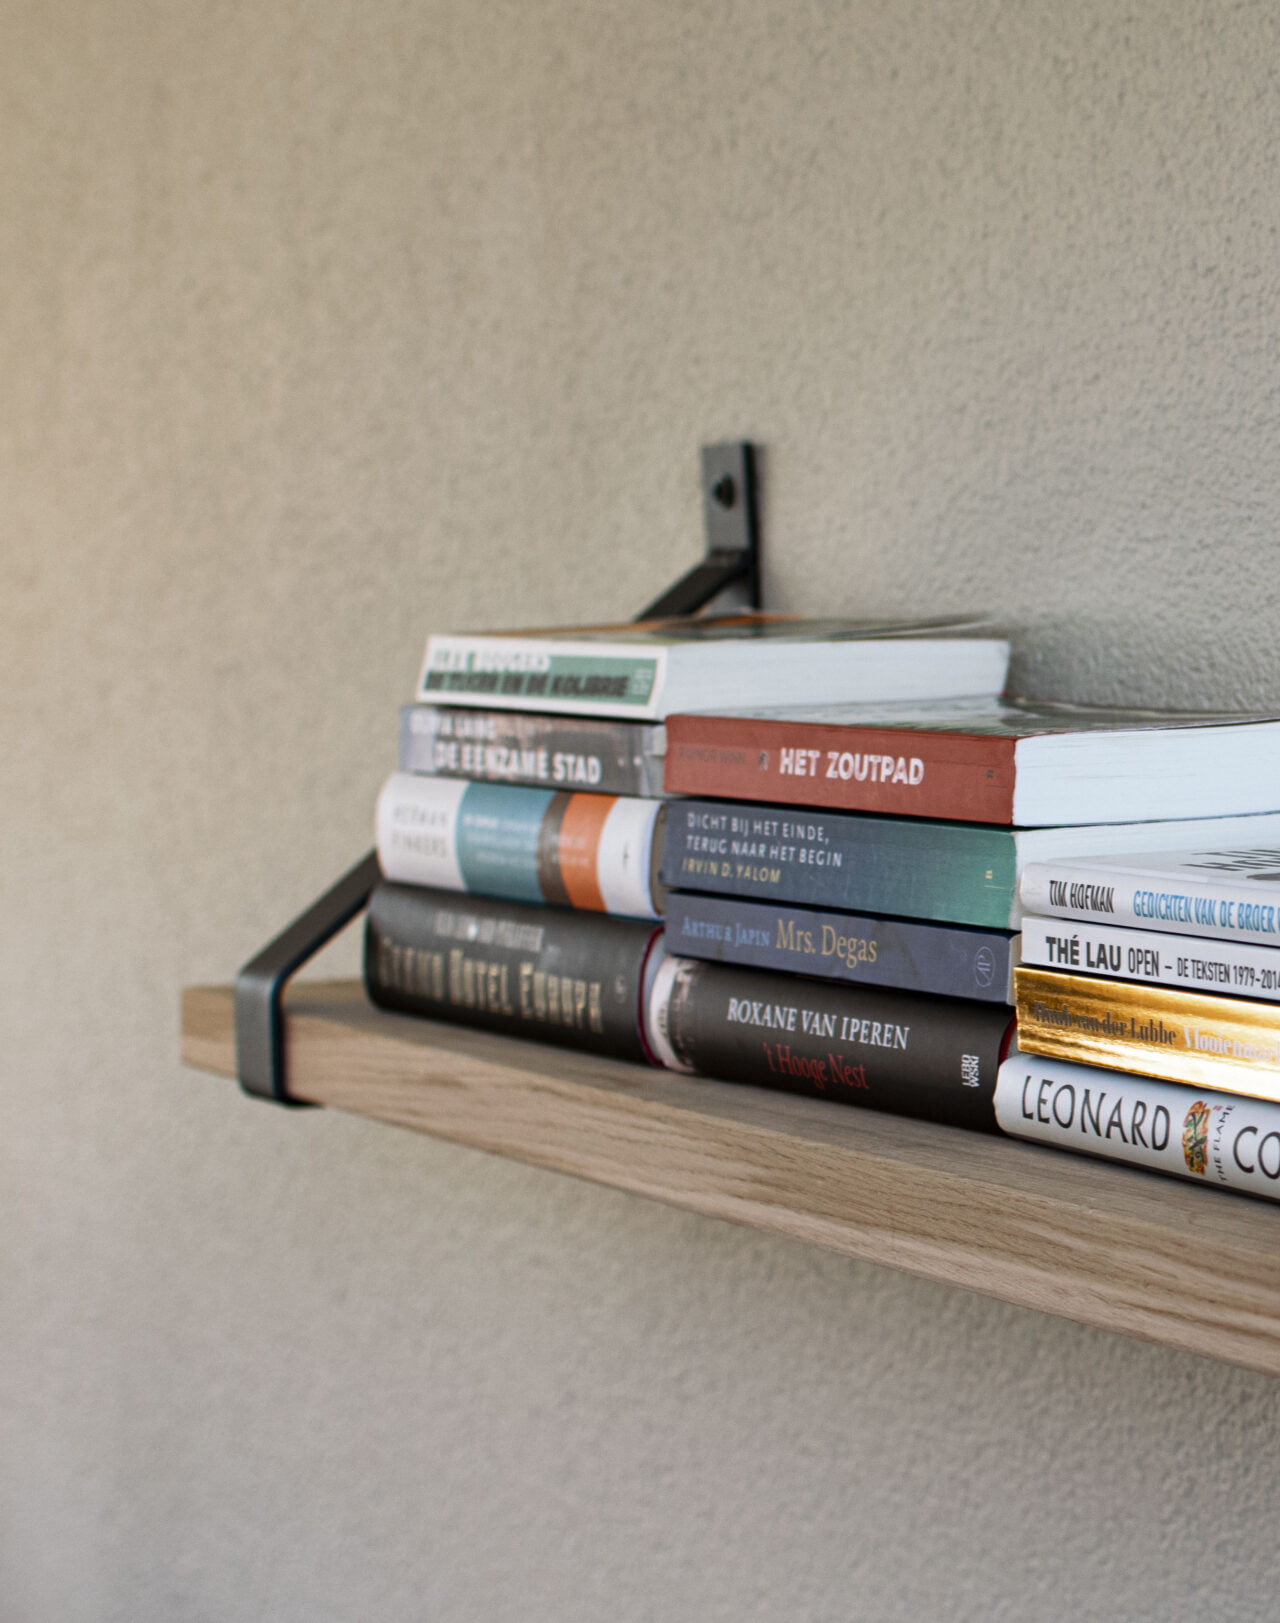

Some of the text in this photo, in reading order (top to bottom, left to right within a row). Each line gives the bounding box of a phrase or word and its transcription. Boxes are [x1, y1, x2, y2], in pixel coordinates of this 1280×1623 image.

[553, 753, 602, 785] STAD
[779, 747, 925, 786] HET ZOUTPAD
[686, 835, 843, 867] TERUG NAAR HET BEGIN
[687, 812, 830, 845] DICHT BIJ HET EINDE,
[682, 858, 781, 884] IRVIN D. YALOM
[1049, 880, 1067, 903] TIM
[1069, 882, 1115, 914] HOFMAN
[1133, 890, 1192, 921] GEDICHTEN
[1193, 899, 1217, 926] VAN
[1219, 902, 1234, 929] DE
[1237, 905, 1275, 935] BROER
[682, 916, 878, 968] ARTHUR JAPIN Mrs. Degas
[1045, 935, 1080, 966] THÉ
[1086, 941, 1122, 972] LAU
[1127, 948, 1160, 977] OPEN
[1177, 961, 1190, 979] DE
[1191, 963, 1231, 984] TEKSTEN
[727, 997, 910, 1051] ROXANE VAN IPEREN
[1077, 1012, 1101, 1032] van
[1102, 1012, 1128, 1037] der
[1130, 1016, 1176, 1046] Lubbe
[778, 1043, 827, 1090] Hooge
[828, 1052, 870, 1090] Nest
[1021, 1075, 1170, 1151] LEONARD
[1213, 1105, 1235, 1180] THE FLAME
